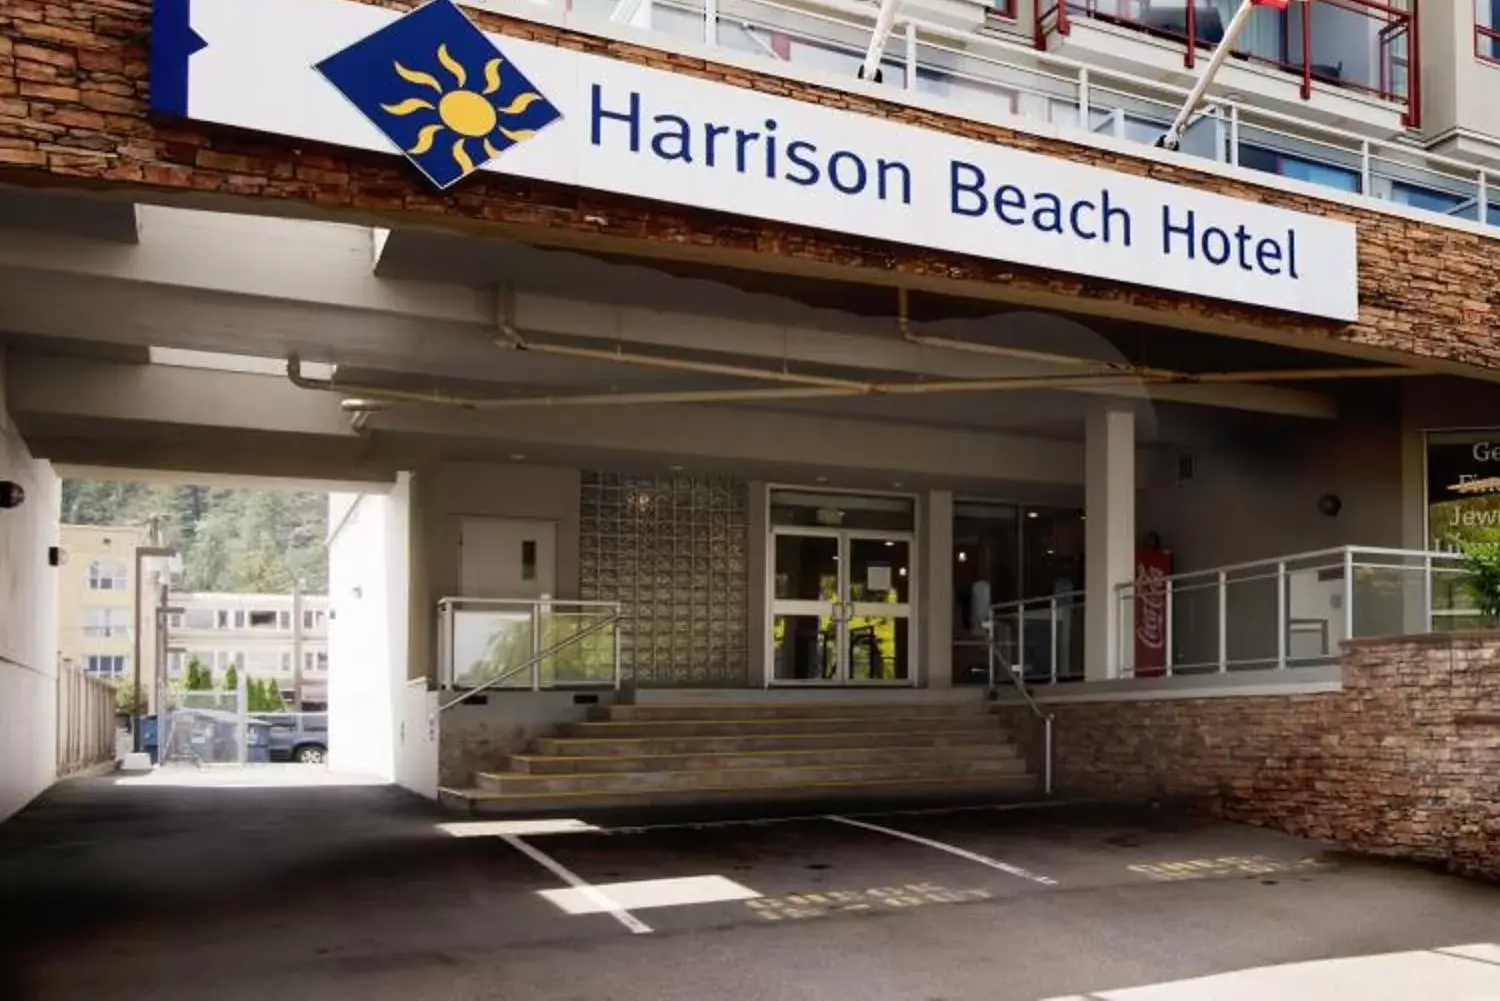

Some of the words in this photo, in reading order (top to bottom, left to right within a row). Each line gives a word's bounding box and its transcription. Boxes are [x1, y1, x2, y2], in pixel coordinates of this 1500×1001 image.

[590, 83, 911, 203] Harrison
[950, 160, 1131, 248] Beach
[1162, 205, 1297, 278] Hotel
